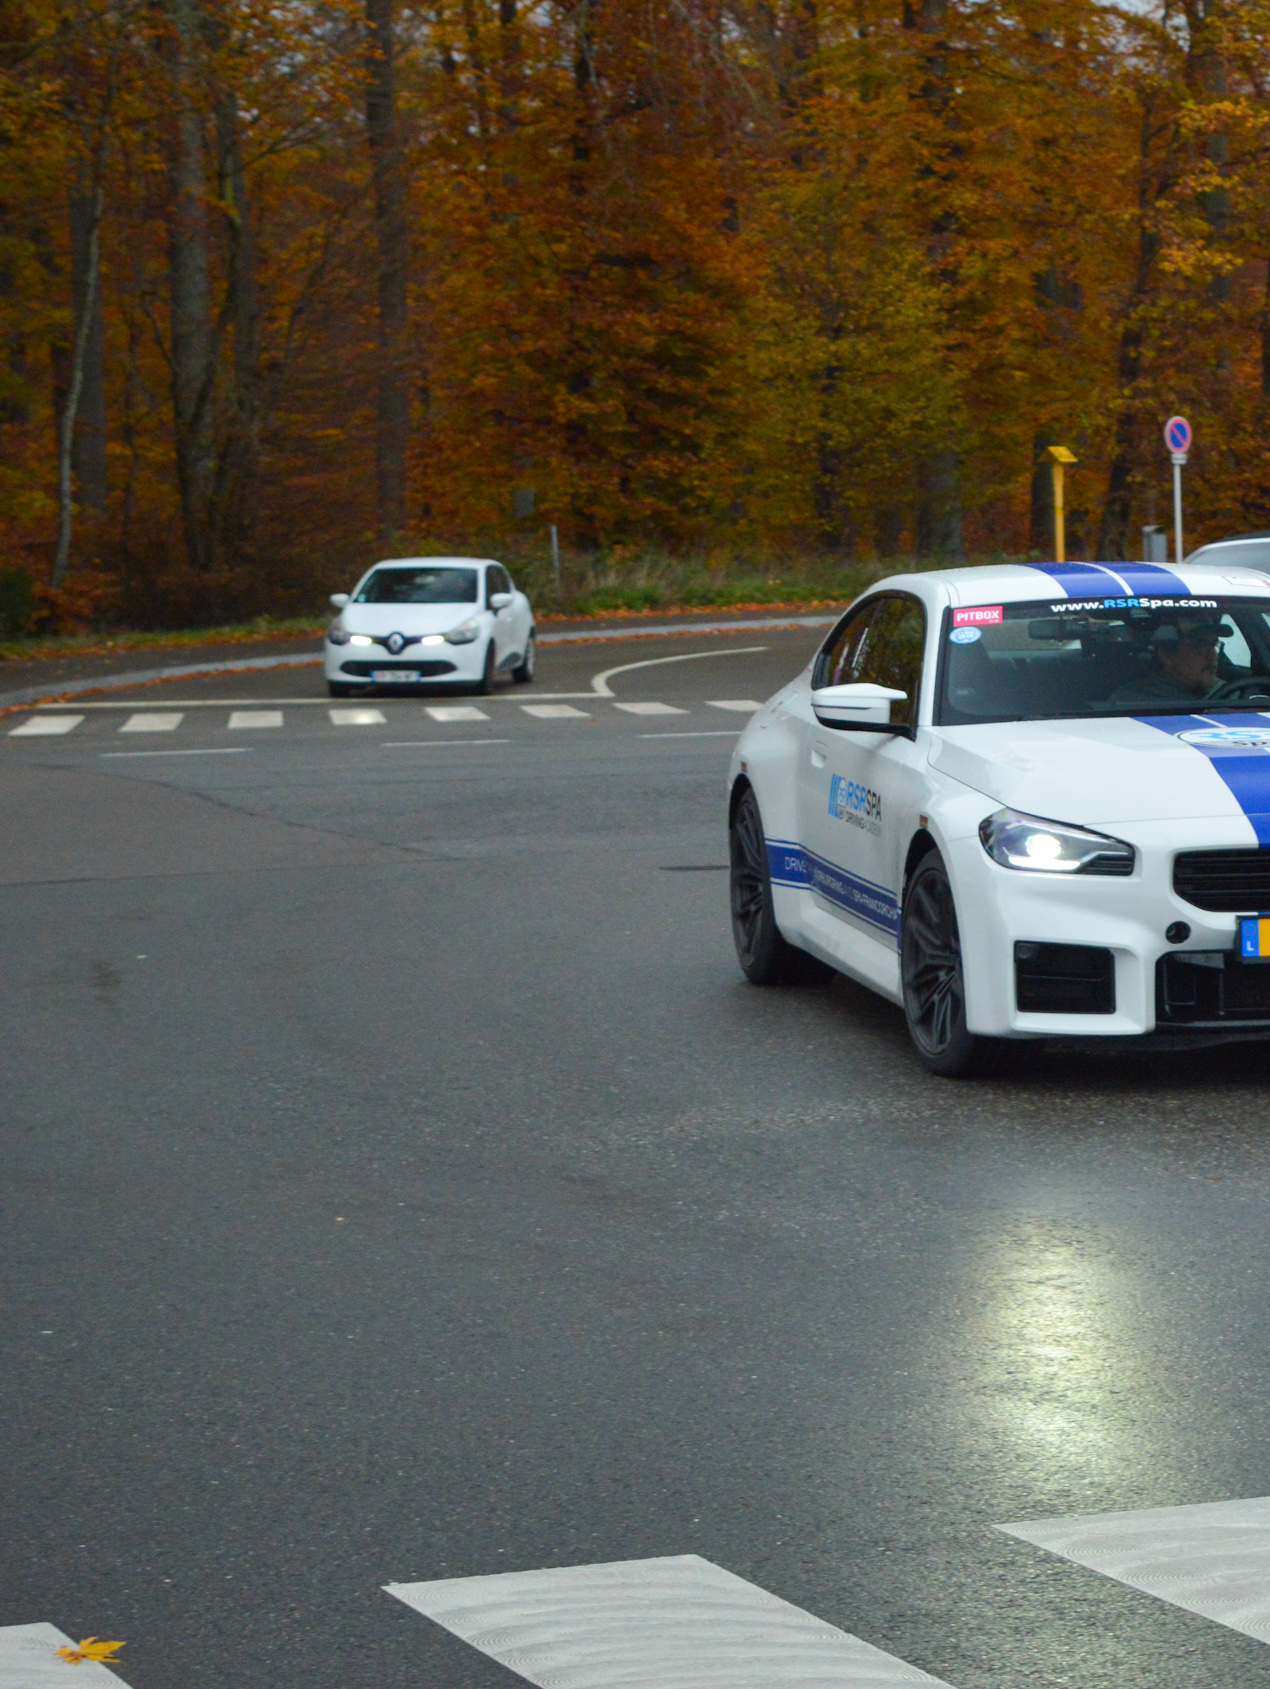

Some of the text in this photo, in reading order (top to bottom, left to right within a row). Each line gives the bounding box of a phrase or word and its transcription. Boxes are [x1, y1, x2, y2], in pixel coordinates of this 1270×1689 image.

[1051, 598, 1218, 612] www.RSRSpa.com
[956, 610, 1000, 622] PITBOX
[1246, 940, 1255, 951] L
